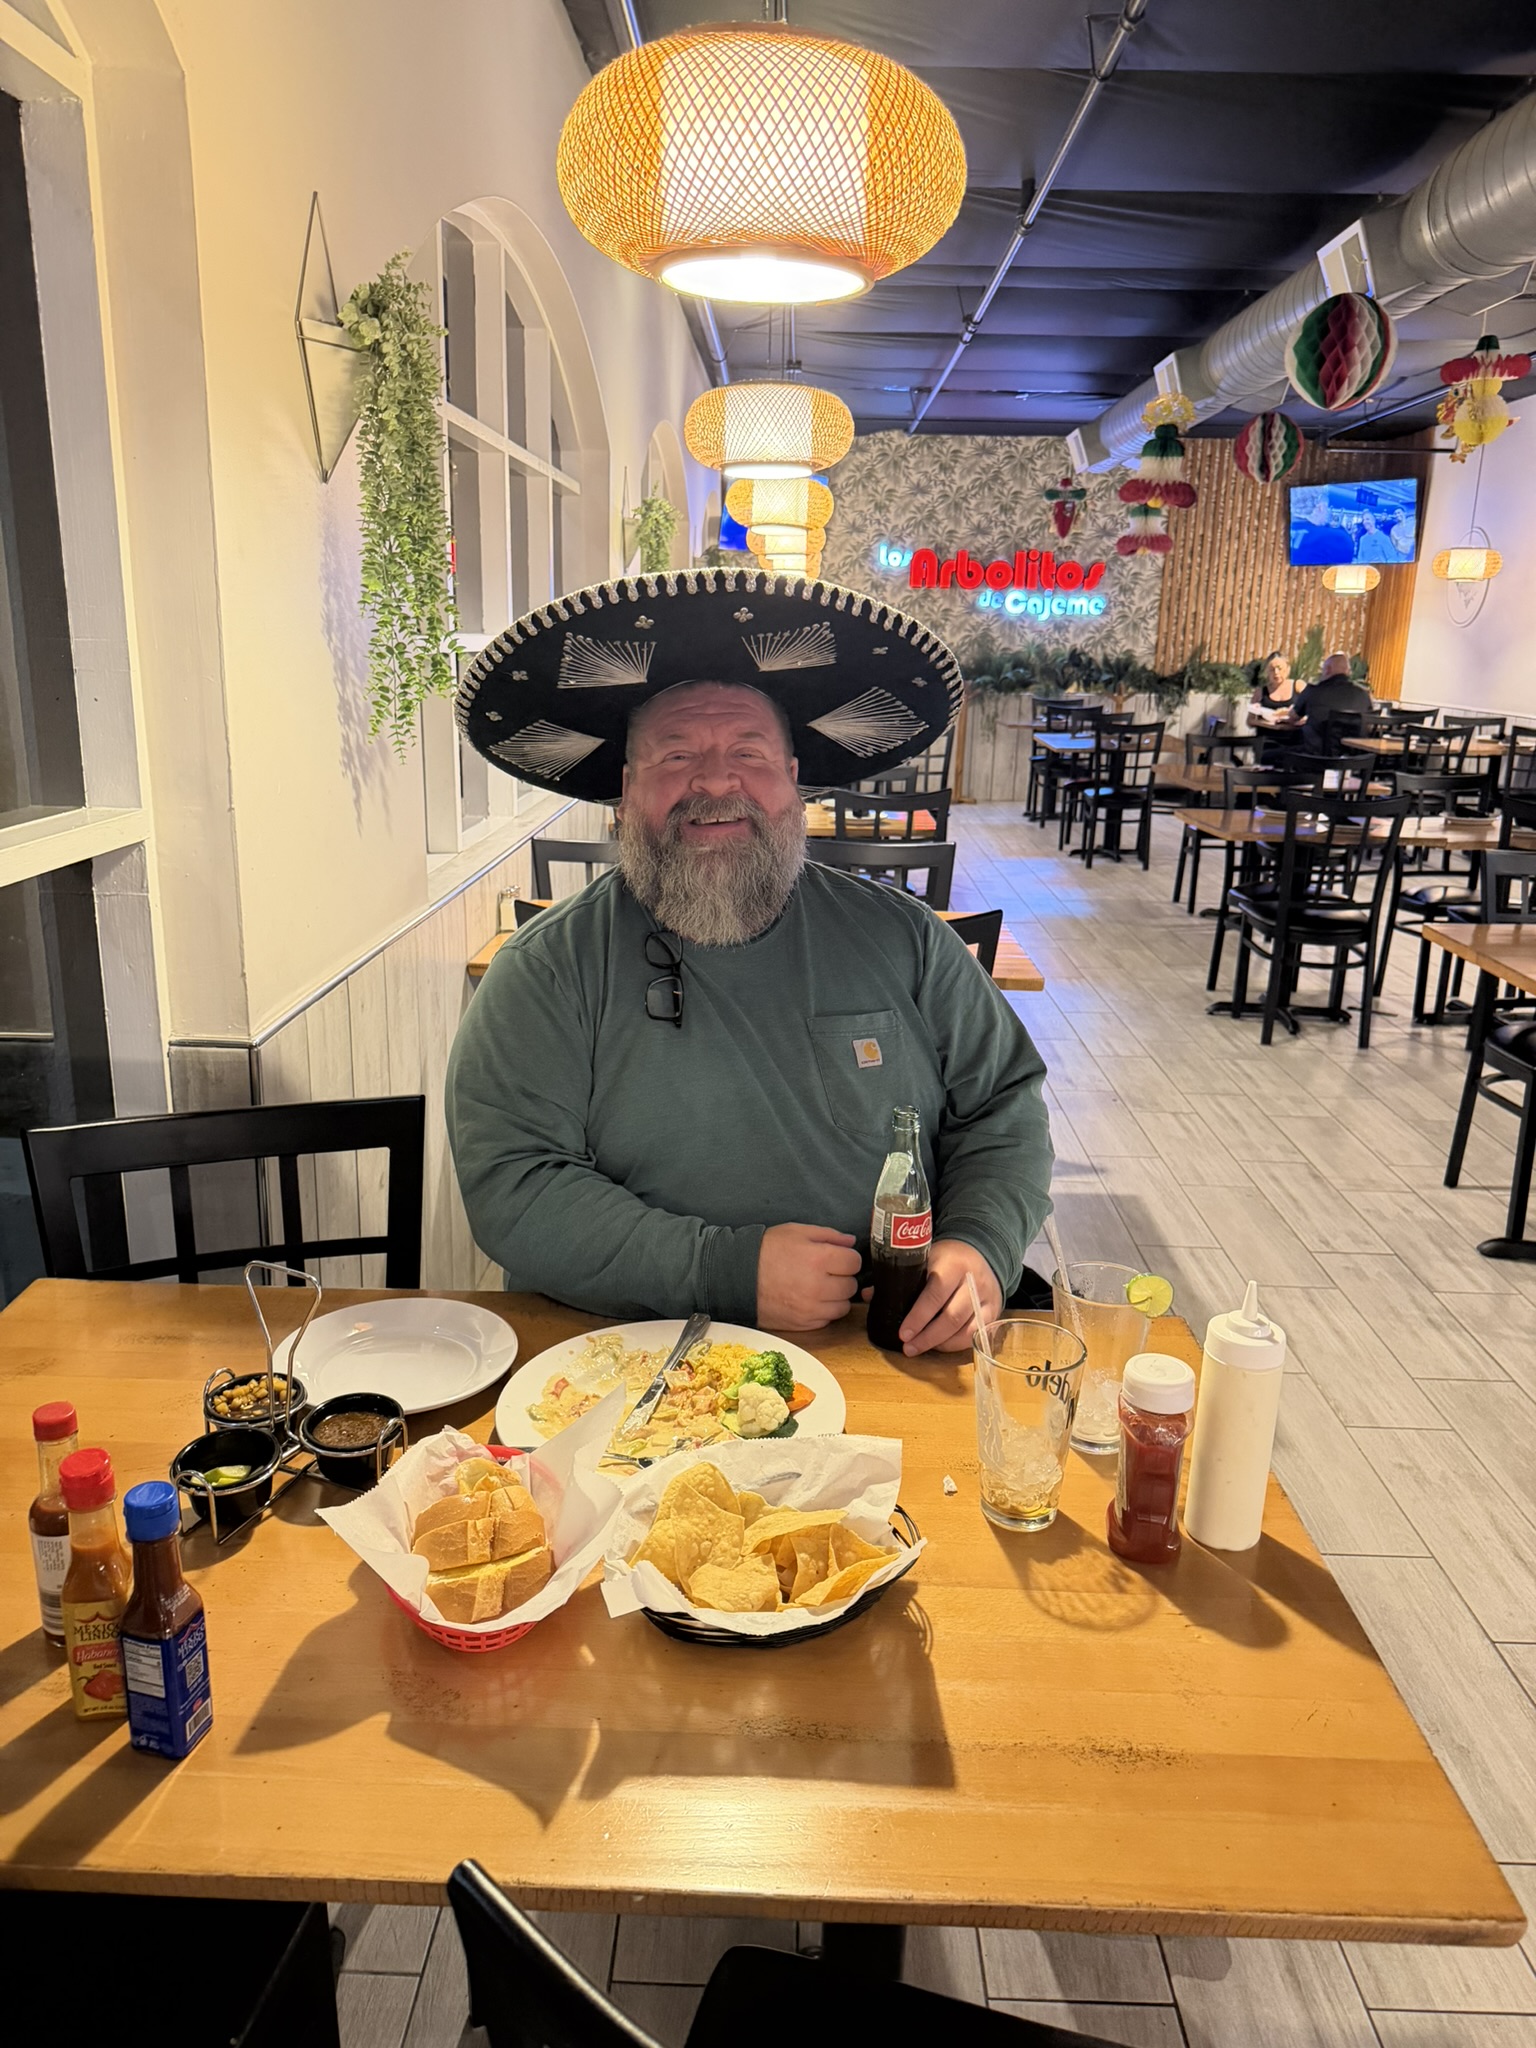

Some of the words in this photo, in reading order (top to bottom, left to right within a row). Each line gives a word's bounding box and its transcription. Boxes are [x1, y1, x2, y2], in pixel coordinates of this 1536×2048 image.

[909, 548, 1106, 590] Arbolitos
[1004, 589, 1106, 621] Cajeme
[76, 1649, 120, 1663] Habaner
